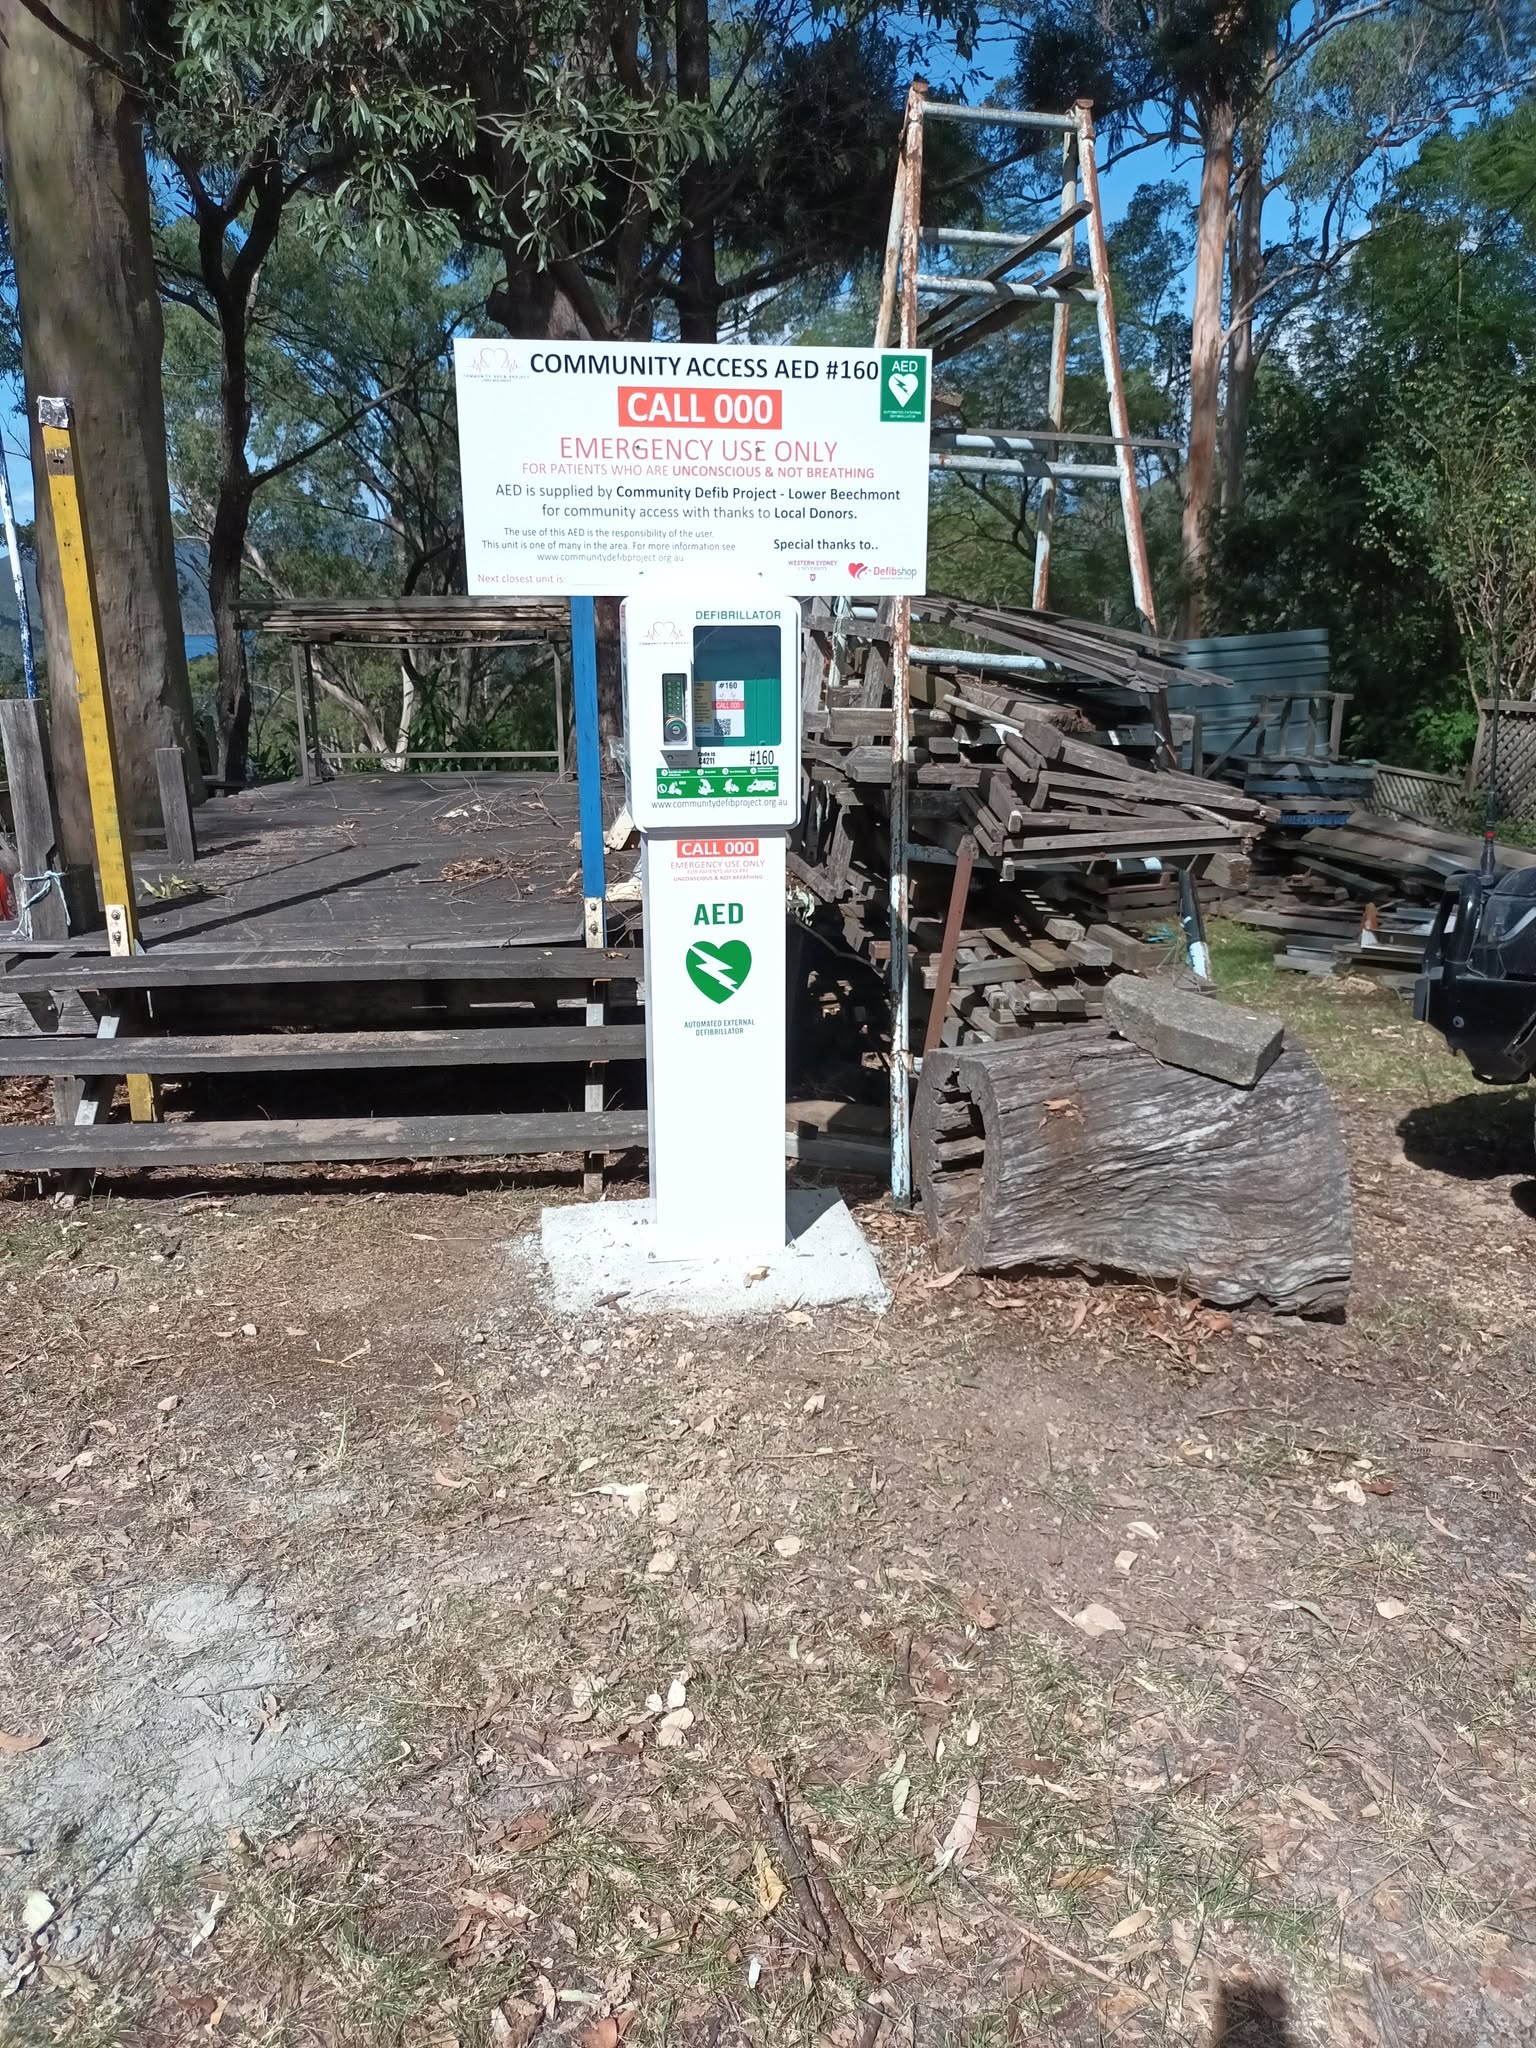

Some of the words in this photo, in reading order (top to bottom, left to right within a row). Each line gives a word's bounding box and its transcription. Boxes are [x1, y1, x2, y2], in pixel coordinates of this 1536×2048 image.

[530, 353, 681, 376] COMMUNITY
[686, 357, 767, 378] ACCESS
[775, 360, 818, 379] AED
[826, 361, 878, 380] #160
[892, 360, 918, 372] AED
[627, 392, 705, 423] CALL
[714, 394, 773, 424] 000
[561, 437, 713, 461] EMERGENCY
[723, 440, 766, 461] USE
[775, 441, 838, 462] ONLY
[522, 463, 546, 475] FOR
[551, 464, 607, 476] PATIENTS
[611, 465, 642, 476] WHO
[646, 465, 668, 476] ARE
[673, 466, 761, 477] UNCONSCIOUS
[765, 467, 774, 477] &
[778, 468, 803, 478] NOT
[807, 468, 874, 478] BREATHING
[496, 485, 522, 497] AED
[526, 485, 536, 497] is
[540, 485, 593, 499] supplied
[598, 485, 612, 500] by
[617, 486, 690, 500] Community
[695, 487, 729, 499] Defib
[733, 488, 777, 501] Project
[788, 489, 826, 500] Lower
[830, 489, 900, 500] Beechmont
[542, 504, 560, 516] for
[564, 506, 635, 519] community
[640, 509, 679, 518] access
[683, 507, 709, 518] with
[714, 508, 754, 518] thanks
[758, 509, 770, 518] to
[774, 508, 805, 519] Local
[809, 508, 857, 519] Donors.
[504, 528, 520, 536] The
[539, 528, 548, 536] of
[550, 528, 565, 537] this
[568, 528, 585, 537] AED
[587, 528, 593, 537] is
[595, 528, 609, 537] the
[612, 528, 666, 539] responsibility
[669, 529, 678, 537] of
[680, 529, 694, 538] the
[482, 541, 499, 549] This
[501, 541, 518, 549] unit
[520, 541, 527, 549] is
[548, 541, 556, 550] of
[559, 543, 581, 551] many
[584, 542, 591, 550] in
[593, 542, 607, 550] the
[632, 542, 645, 550] For
[672, 542, 720, 551] information
[774, 539, 814, 551] Special
[818, 540, 856, 550] thanks
[859, 541, 878, 550] to..
[478, 574, 499, 583] Next
[502, 574, 533, 584] closest
[536, 575, 554, 584] unit
[874, 567, 917, 579] Defibshop
[696, 610, 781, 620] DEFIBRILLATOR
[750, 750, 774, 765] #160
[651, 799, 787, 808] www.communitydefibproject.org.au
[682, 843, 720, 855] CALL
[725, 842, 754, 854] 000
[671, 861, 722, 869] EMERGENCY
[694, 903, 744, 925] AED
[684, 1020, 722, 1028] AUTOMATED
[696, 1028, 744, 1036] DEFIBRILLATOR
